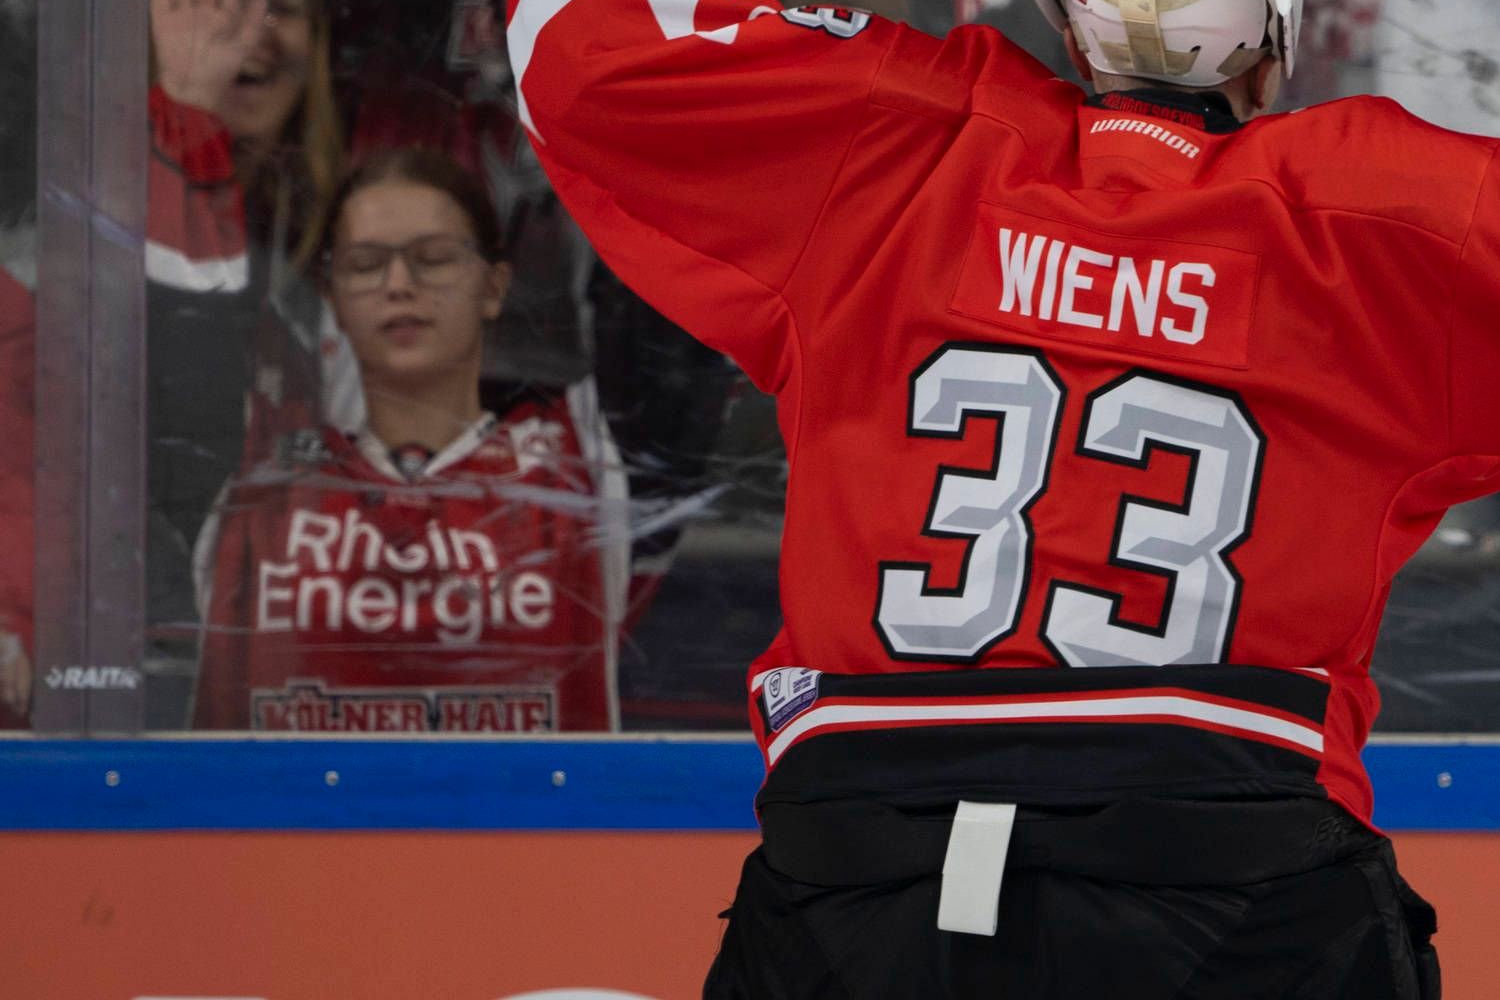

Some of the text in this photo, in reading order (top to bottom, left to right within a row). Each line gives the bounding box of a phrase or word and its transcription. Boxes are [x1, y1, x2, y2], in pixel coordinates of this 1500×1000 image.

[1090, 118, 1200, 160] WARRIOR
[997, 225, 1217, 345] WIENS
[871, 339, 1268, 668] 33
[257, 560, 554, 645] Energie
